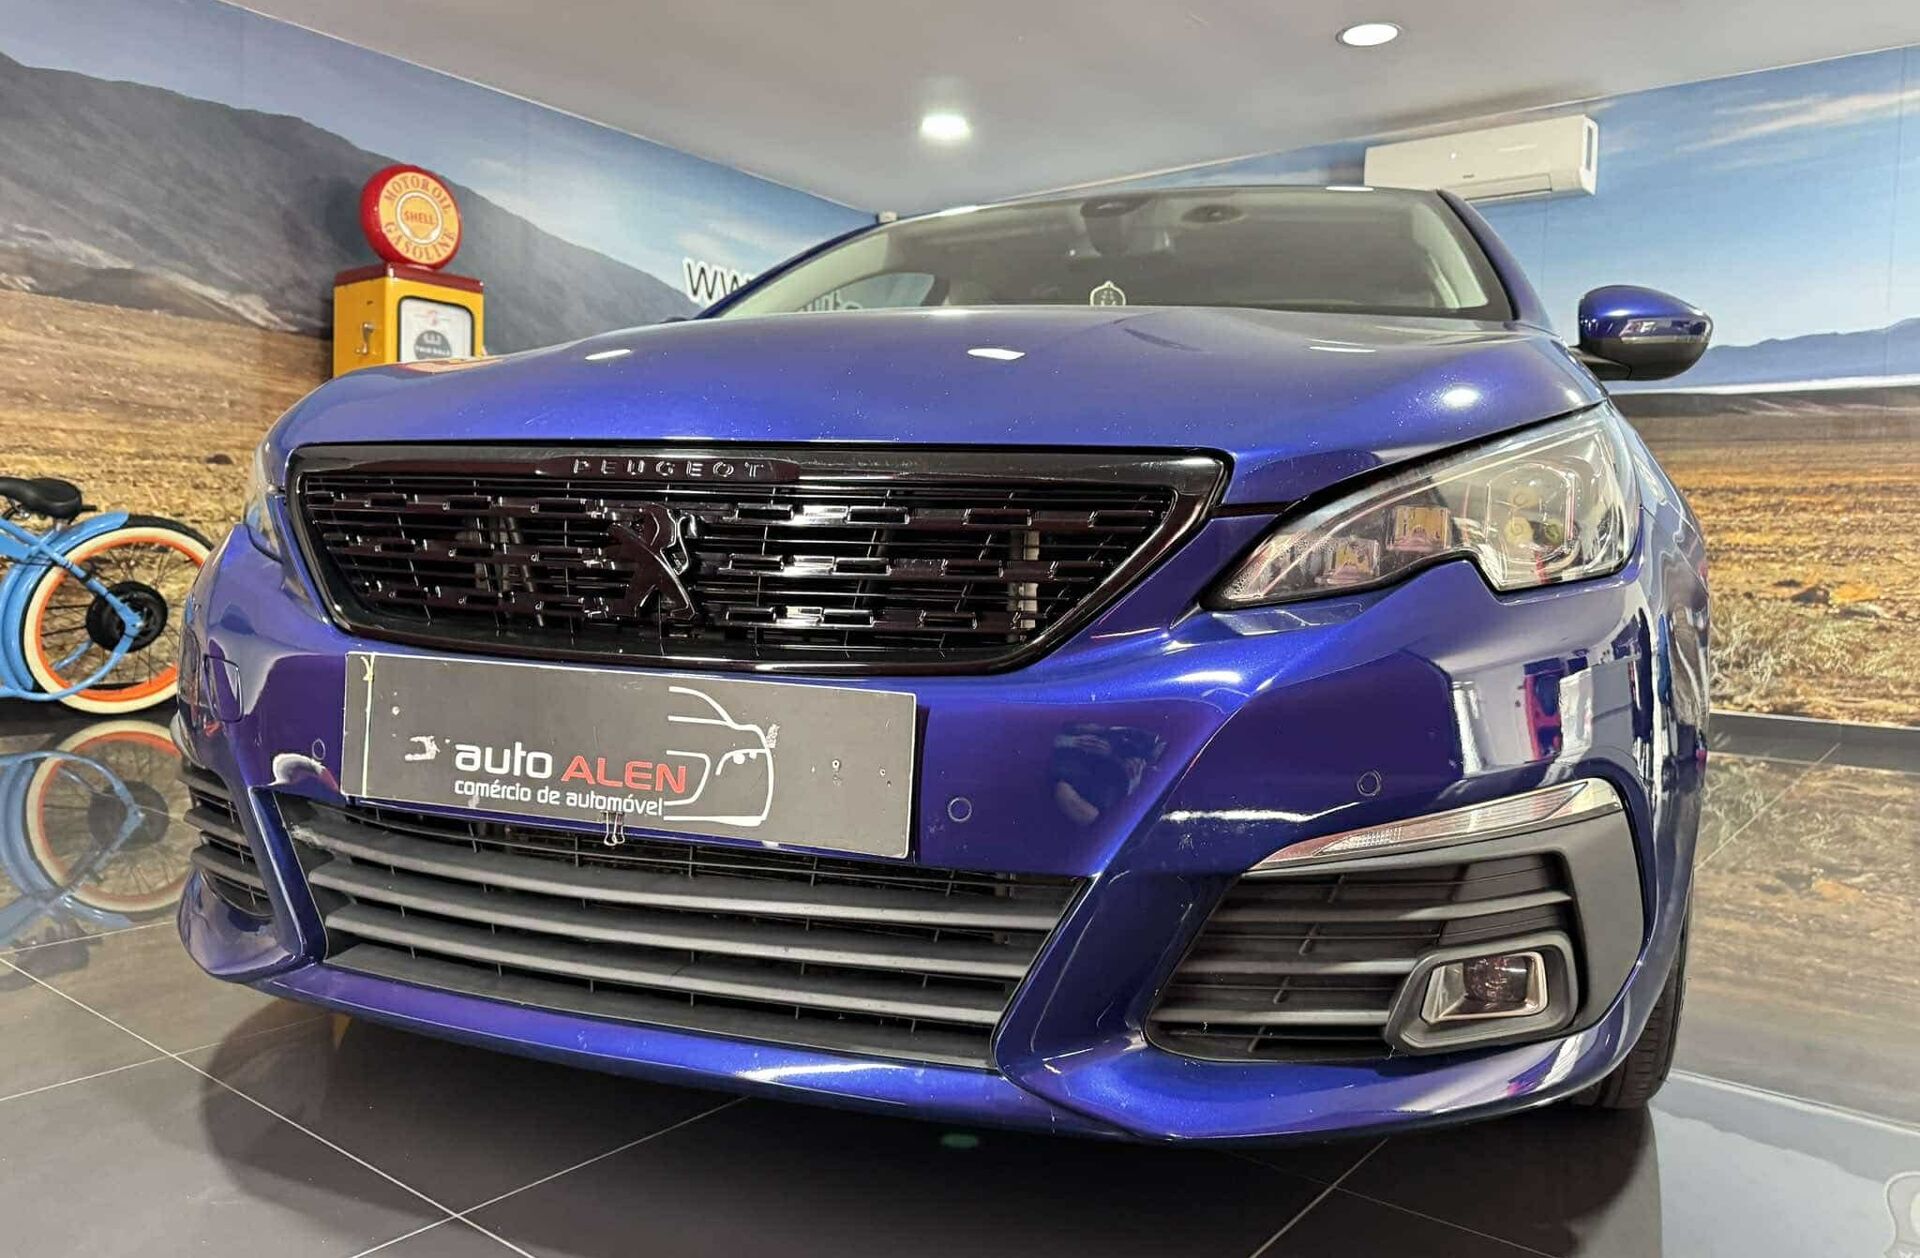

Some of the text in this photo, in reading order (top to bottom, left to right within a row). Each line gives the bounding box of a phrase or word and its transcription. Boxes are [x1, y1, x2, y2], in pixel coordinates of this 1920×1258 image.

[383, 175, 451, 214] MOTOR OIL
[403, 210, 437, 225] SHELL
[384, 221, 456, 261] GASOLINE
[573, 458, 764, 478] PEUGEOT
[455, 741, 687, 794] auto ALEN
[454, 778, 663, 817] comércio de automóvel
